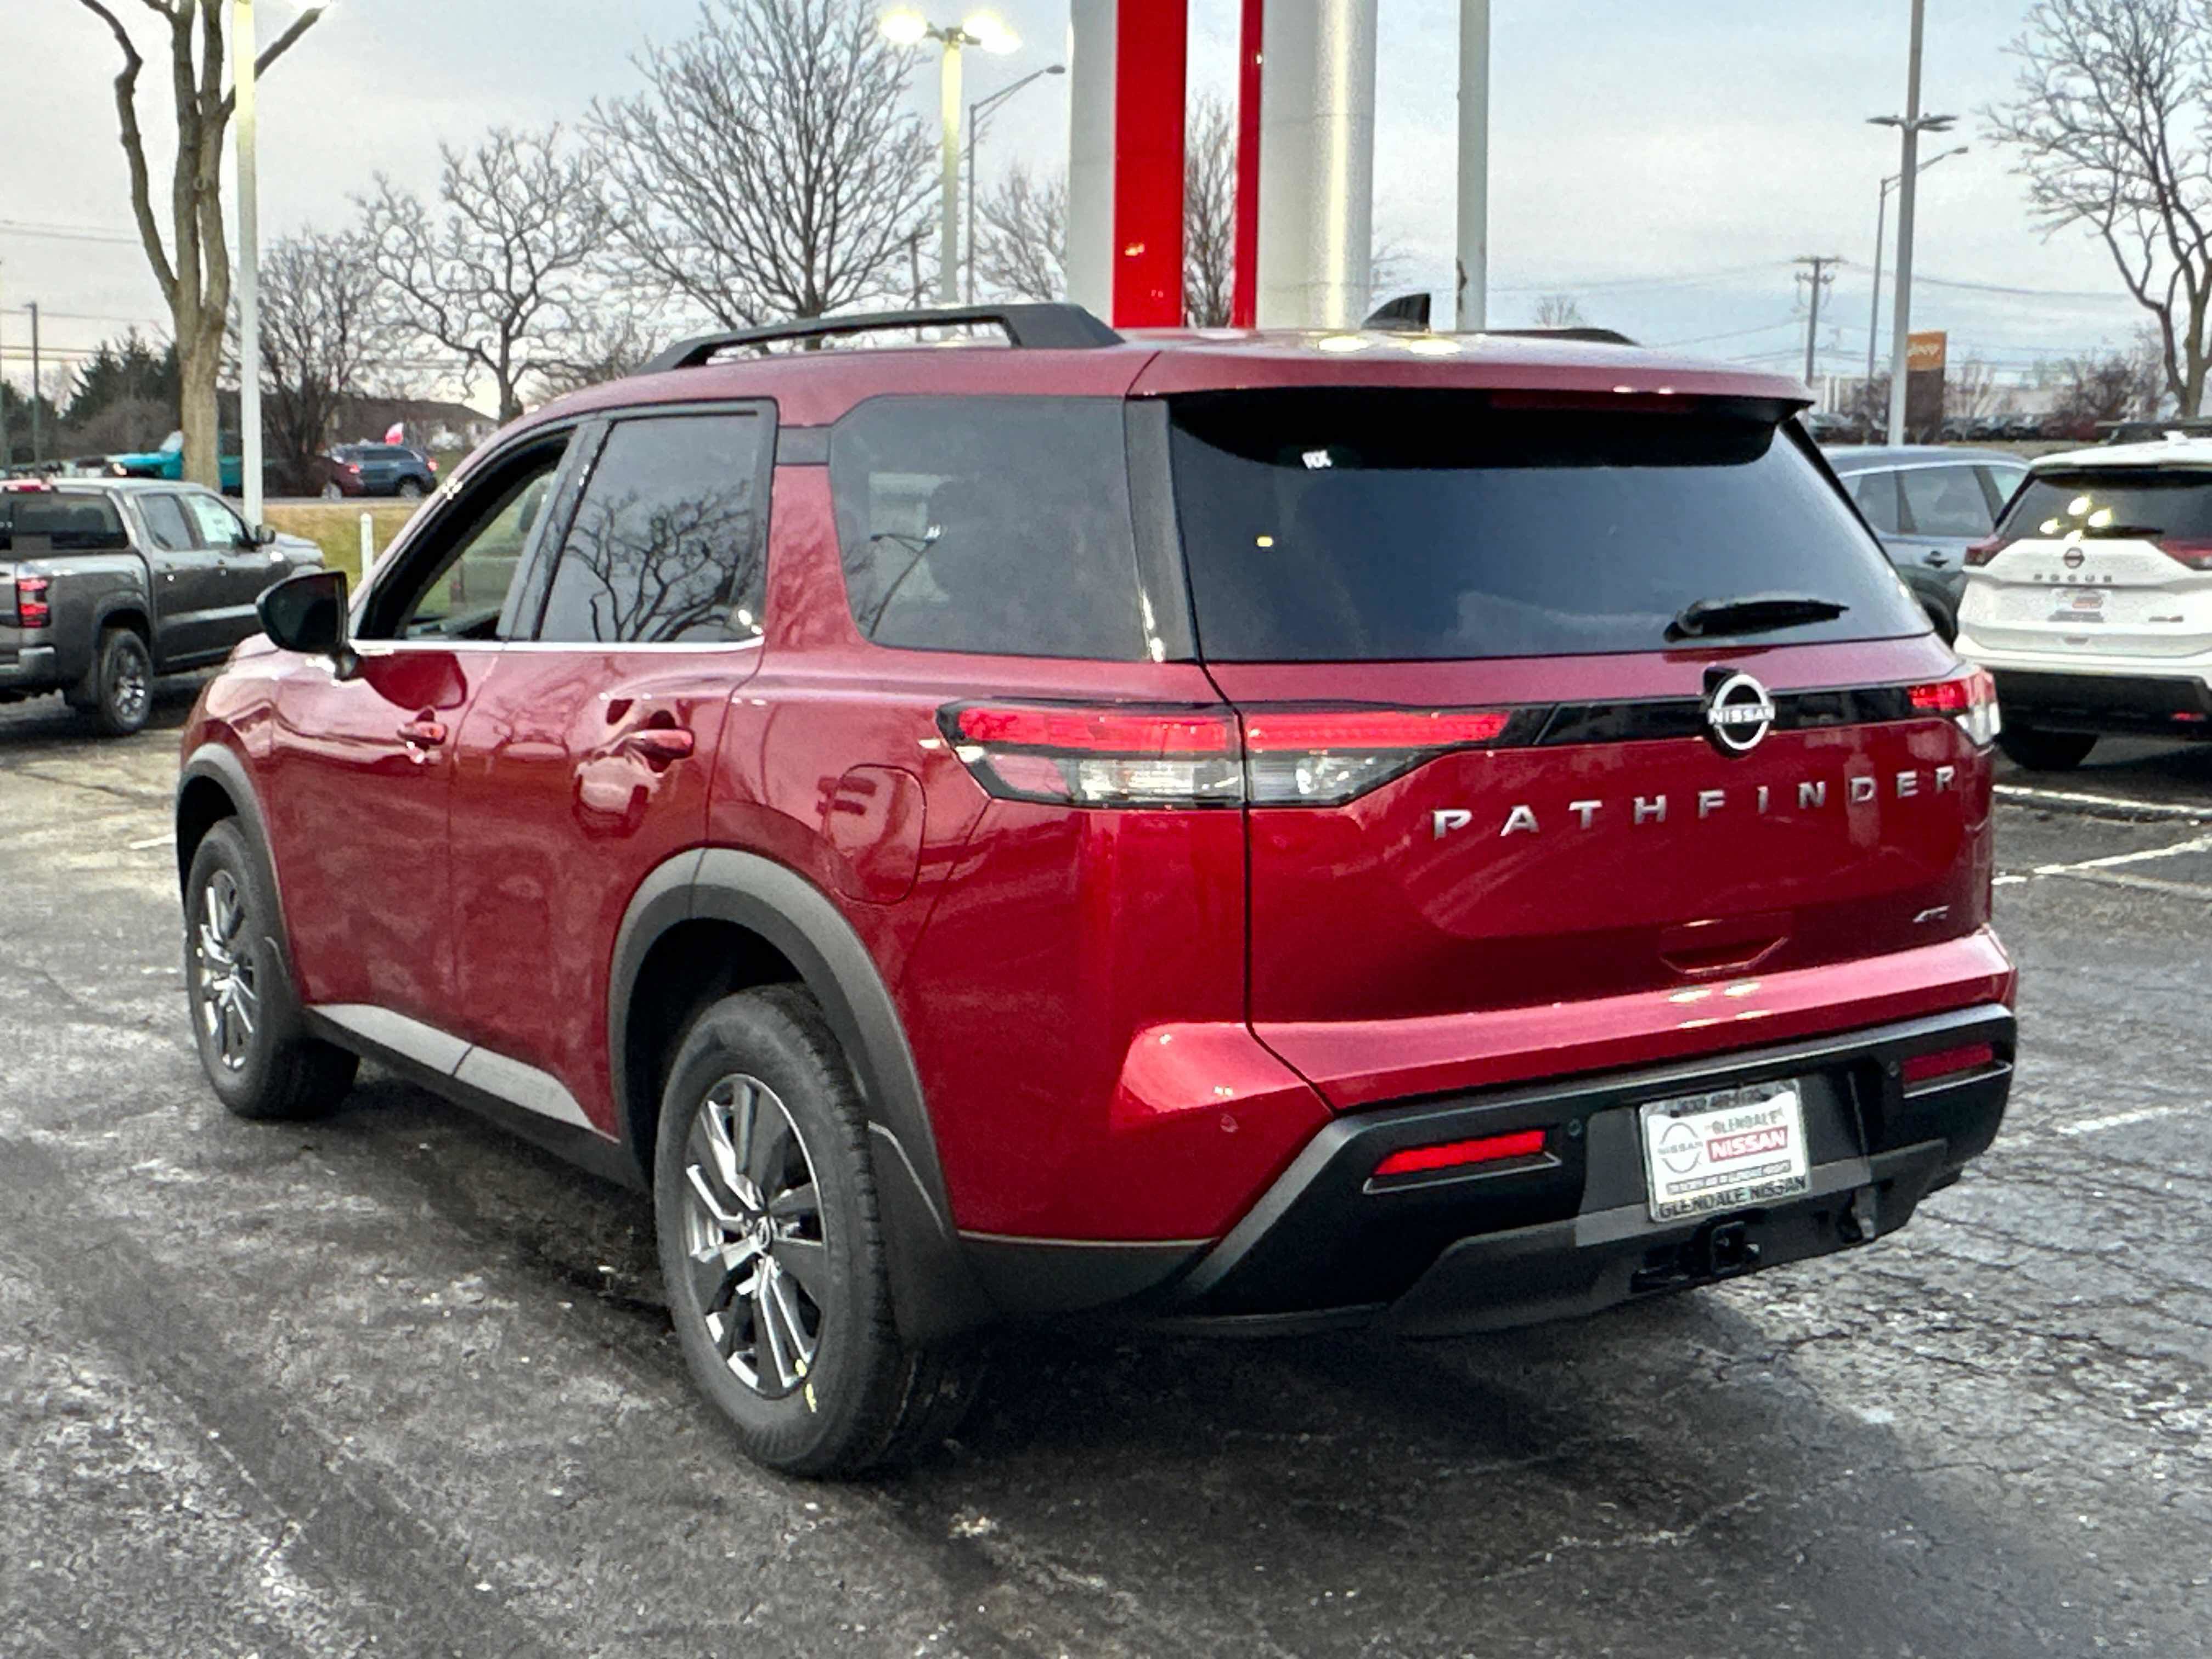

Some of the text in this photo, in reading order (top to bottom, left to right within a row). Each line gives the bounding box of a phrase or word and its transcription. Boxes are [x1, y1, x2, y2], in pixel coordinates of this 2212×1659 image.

[1708, 704, 1775, 724] NISSAN
[1433, 765, 1955, 839] PATHFINDER
[1657, 1140, 1703, 1155] NISSAN
[1710, 1131, 1784, 1159] NISSAN
[1659, 1186, 1750, 1218] GLENDALE
[1750, 1176, 1806, 1200] NISSAN
